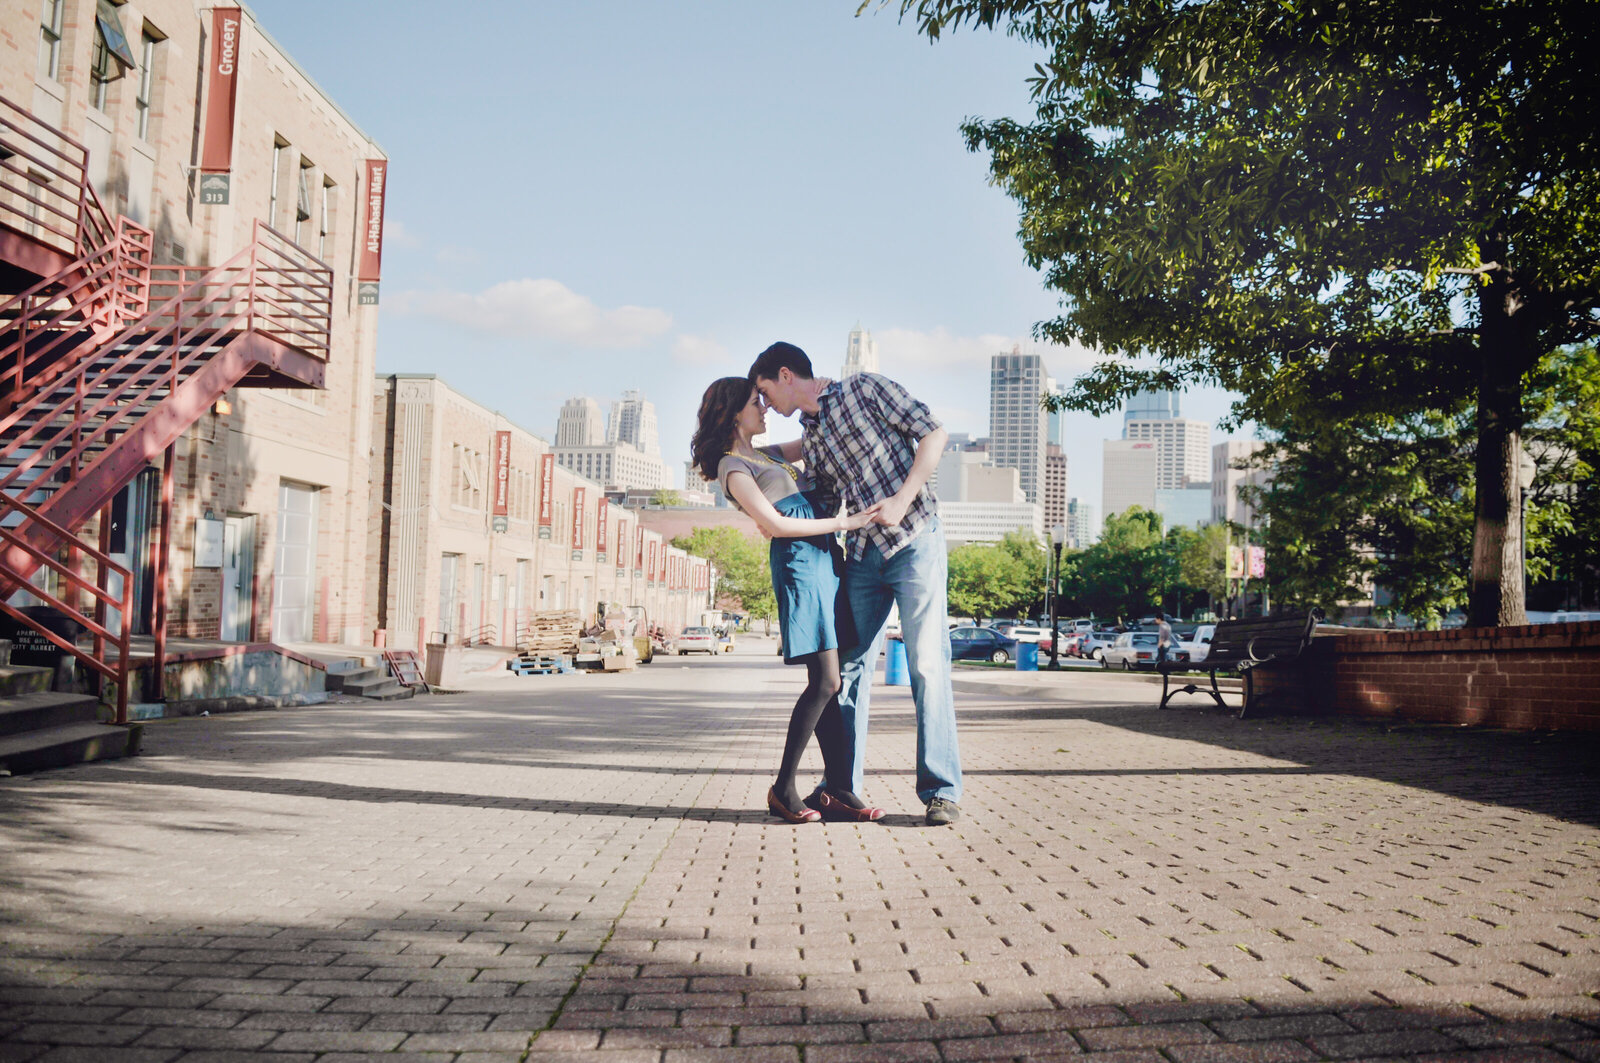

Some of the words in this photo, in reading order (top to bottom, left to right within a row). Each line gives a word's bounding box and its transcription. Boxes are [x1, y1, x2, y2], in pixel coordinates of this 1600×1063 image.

[218, 18, 239, 75] Grocery
[371, 166, 383, 193] Mart
[205, 193, 223, 202] 313
[367, 195, 382, 253] Al-Habashi
[499, 435, 508, 465] Produce
[498, 466, 508, 480] City
